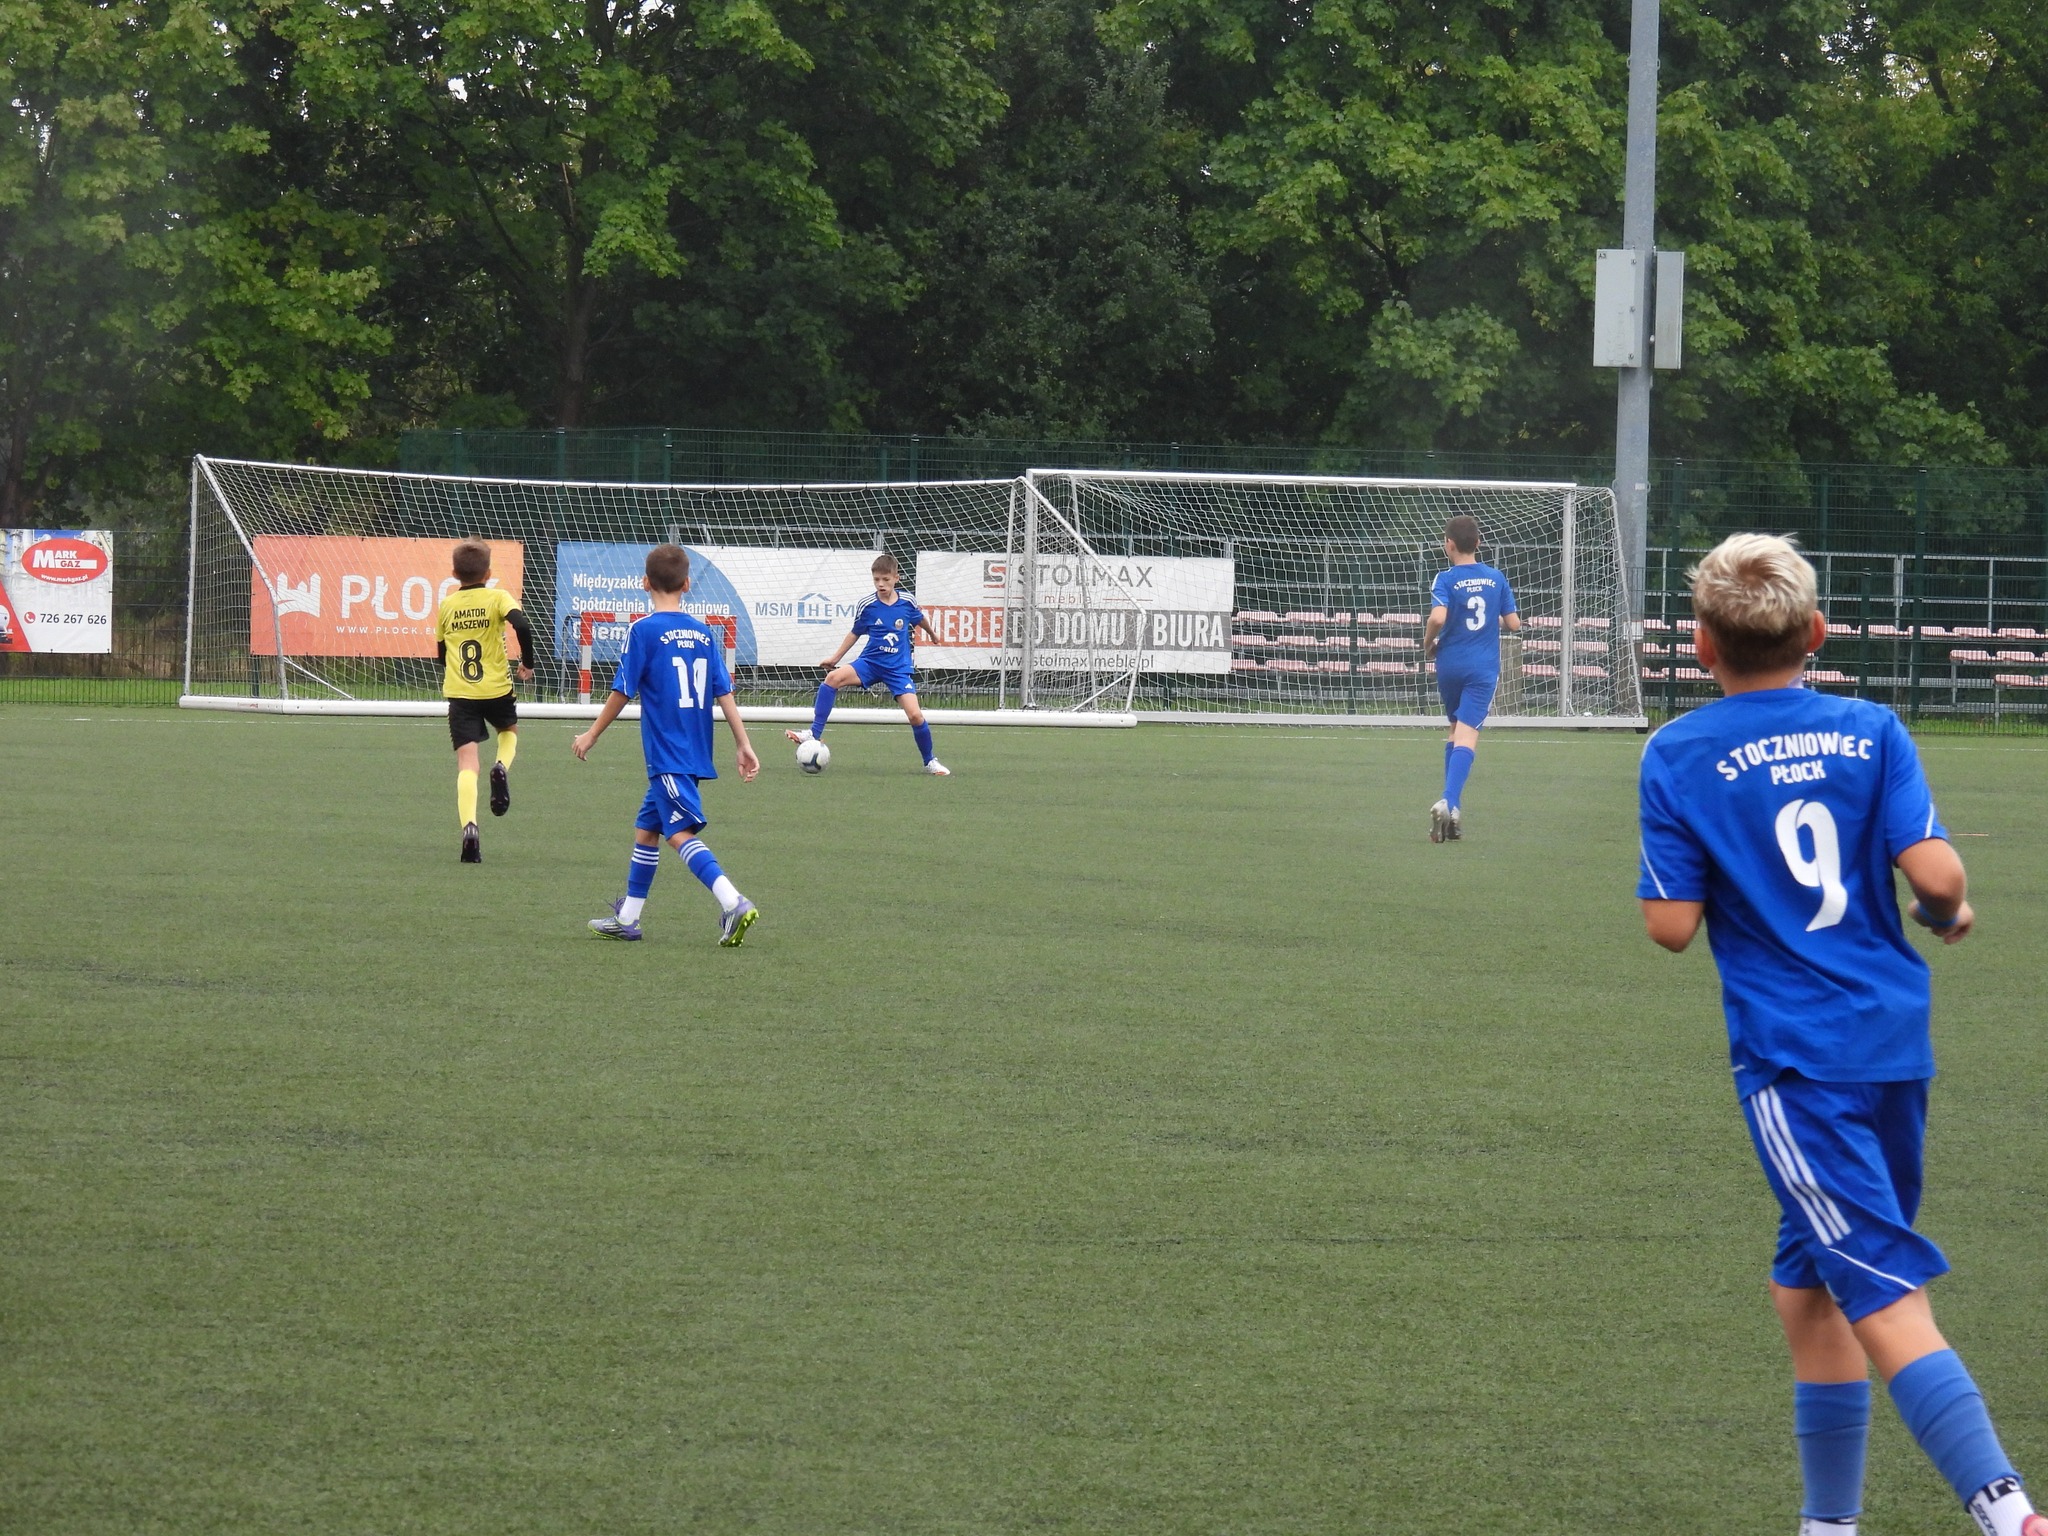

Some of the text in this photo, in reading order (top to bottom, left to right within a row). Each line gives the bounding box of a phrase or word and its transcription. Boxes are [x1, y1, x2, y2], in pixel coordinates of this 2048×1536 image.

[32, 549, 78, 569] MARK
[60, 560, 81, 568] GAZ
[40, 573, 88, 584] www.markgaz.pl
[573, 573, 645, 592] Międzyzakła
[1453, 578, 1496, 591] STOCZNIOWIEC
[341, 574, 499, 621] PŁO
[572, 597, 730, 615] Spółdzielnia Mkaniowa
[453, 608, 486, 620] AMATOR
[755, 602, 793, 617] MSM
[1465, 595, 1486, 631] 3
[40, 613, 107, 625] 726 267 626
[451, 619, 490, 631] MASZEWO
[920, 609, 1003, 643] MEBLE
[1054, 611, 1126, 646] DOMU
[1153, 613, 1225, 648] BIURA
[660, 629, 711, 647] STOCZNIOWIEC
[458, 639, 484, 684] 8
[1716, 732, 1873, 782] STOCZNIOWIEC
[1770, 760, 1826, 785] PŁOCK
[1774, 798, 1848, 932] 9
